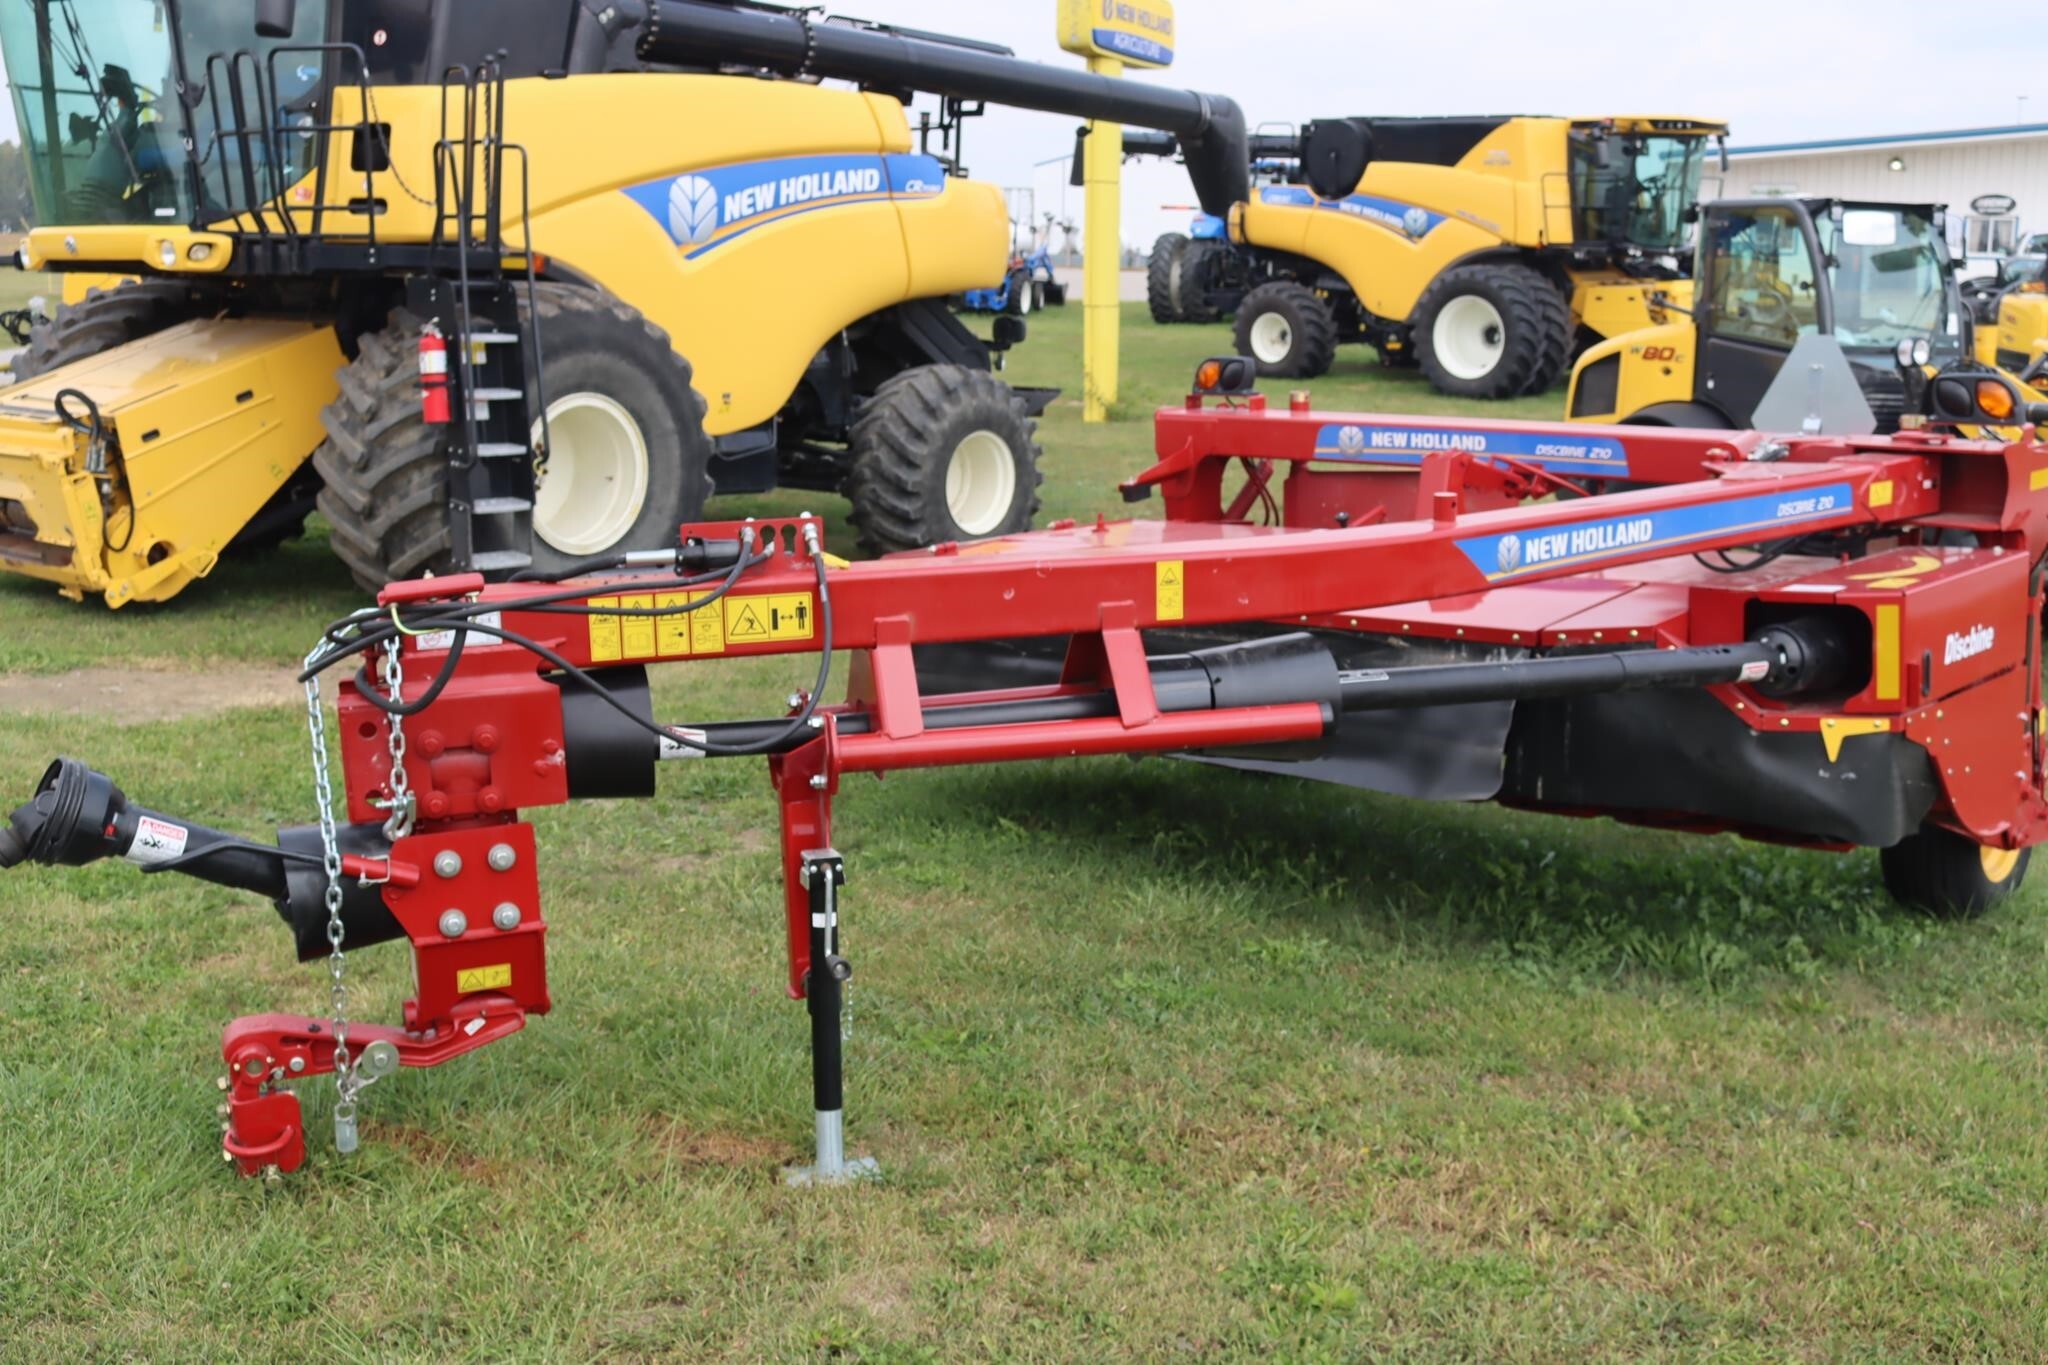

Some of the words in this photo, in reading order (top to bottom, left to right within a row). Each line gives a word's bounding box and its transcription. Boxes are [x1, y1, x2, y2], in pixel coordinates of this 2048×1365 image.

[1115, 2, 1137, 25] NEW
[1137, 8, 1172, 36] HOLLAND
[1112, 32, 1161, 60] AGRICULTURE
[724, 181, 776, 223] NEW
[779, 168, 881, 205] HOLLAND
[1371, 431, 1408, 448] NEW
[1410, 432, 1487, 451] HOLLAND
[1535, 444, 1587, 457] DISCBINE
[1589, 446, 1613, 459] 210
[1525, 532, 1571, 564] NEW
[1571, 518, 1653, 554] HOLLAND
[1776, 498, 1816, 518] DISCBINE
[1944, 623, 1995, 665] Discbine
